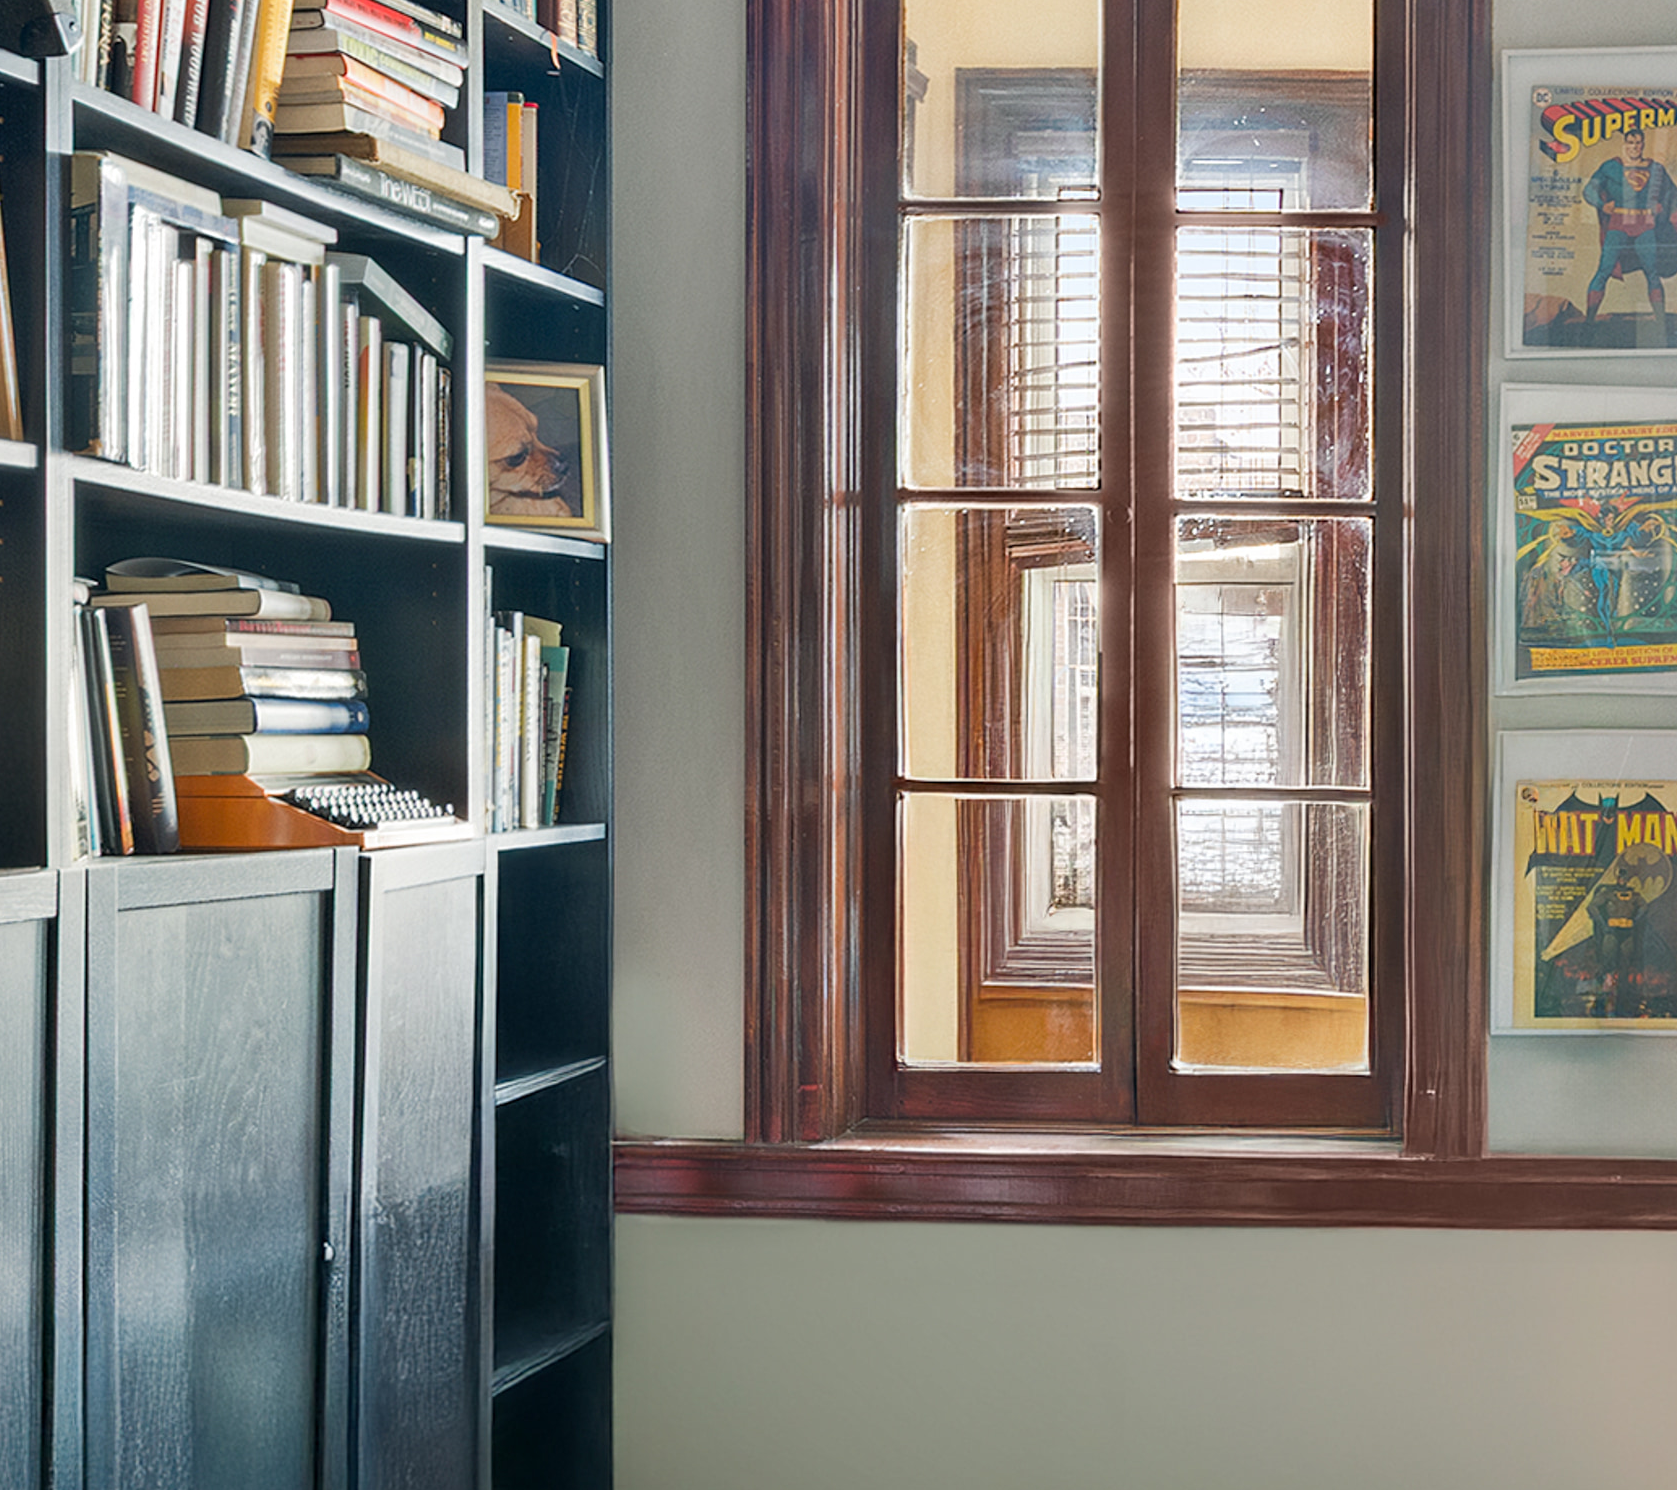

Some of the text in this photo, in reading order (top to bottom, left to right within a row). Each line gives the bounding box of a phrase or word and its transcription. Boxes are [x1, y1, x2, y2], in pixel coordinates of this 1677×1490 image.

[183, 28, 202, 130] WOODWARD
[1552, 428, 1597, 440] MARVEL
[1599, 426, 1654, 438] TREASURY
[1563, 438, 1675, 457] DOCTOR
